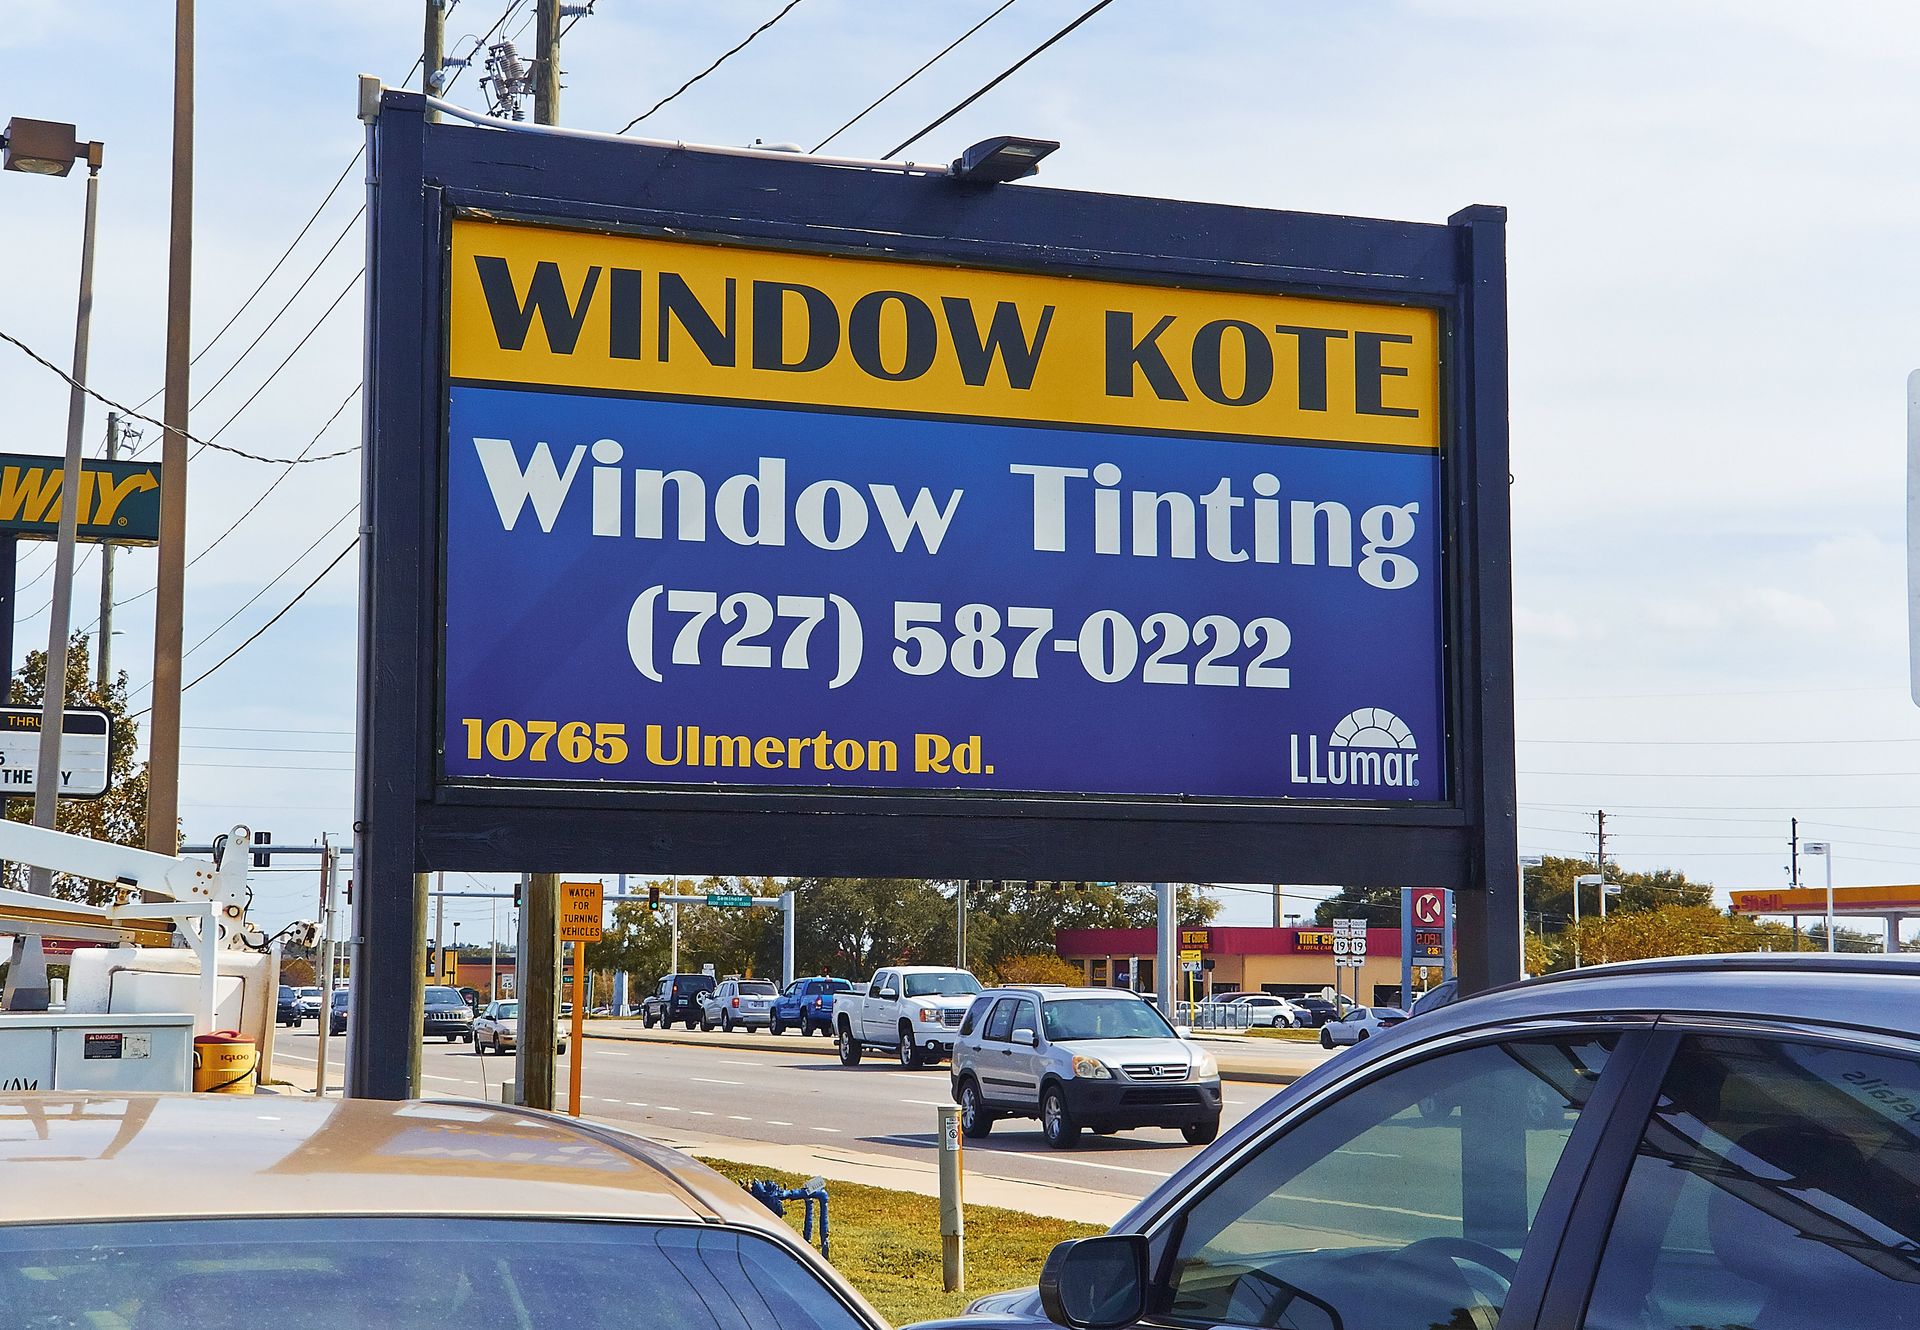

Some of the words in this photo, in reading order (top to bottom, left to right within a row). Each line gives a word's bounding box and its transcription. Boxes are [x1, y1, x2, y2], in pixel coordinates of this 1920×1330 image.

[474, 255, 1055, 391] WINDOW
[1106, 311, 1419, 419] KOTE
[473, 438, 964, 555] Window
[1010, 462, 1420, 591] Tinting
[627, 584, 864, 690] (727)
[892, 601, 1292, 689] 587-0222
[462, 718, 629, 764] 10765
[645, 724, 898, 773] Ulmerton
[914, 734, 995, 776] Rd.
[1290, 734, 1419, 787] LLumar
[2, 769, 33, 784] THE
[569, 889, 595, 897] WATCH
[573, 901, 589, 910] FOR
[1420, 897, 1441, 921] K
[1741, 894, 1782, 911] Shell
[564, 914, 599, 923] TURNING
[561, 927, 600, 936] VEHICLES
[1298, 932, 1319, 945] TIRE
[1336, 941, 1346, 951] 19
[1354, 941, 1364, 951] 19
